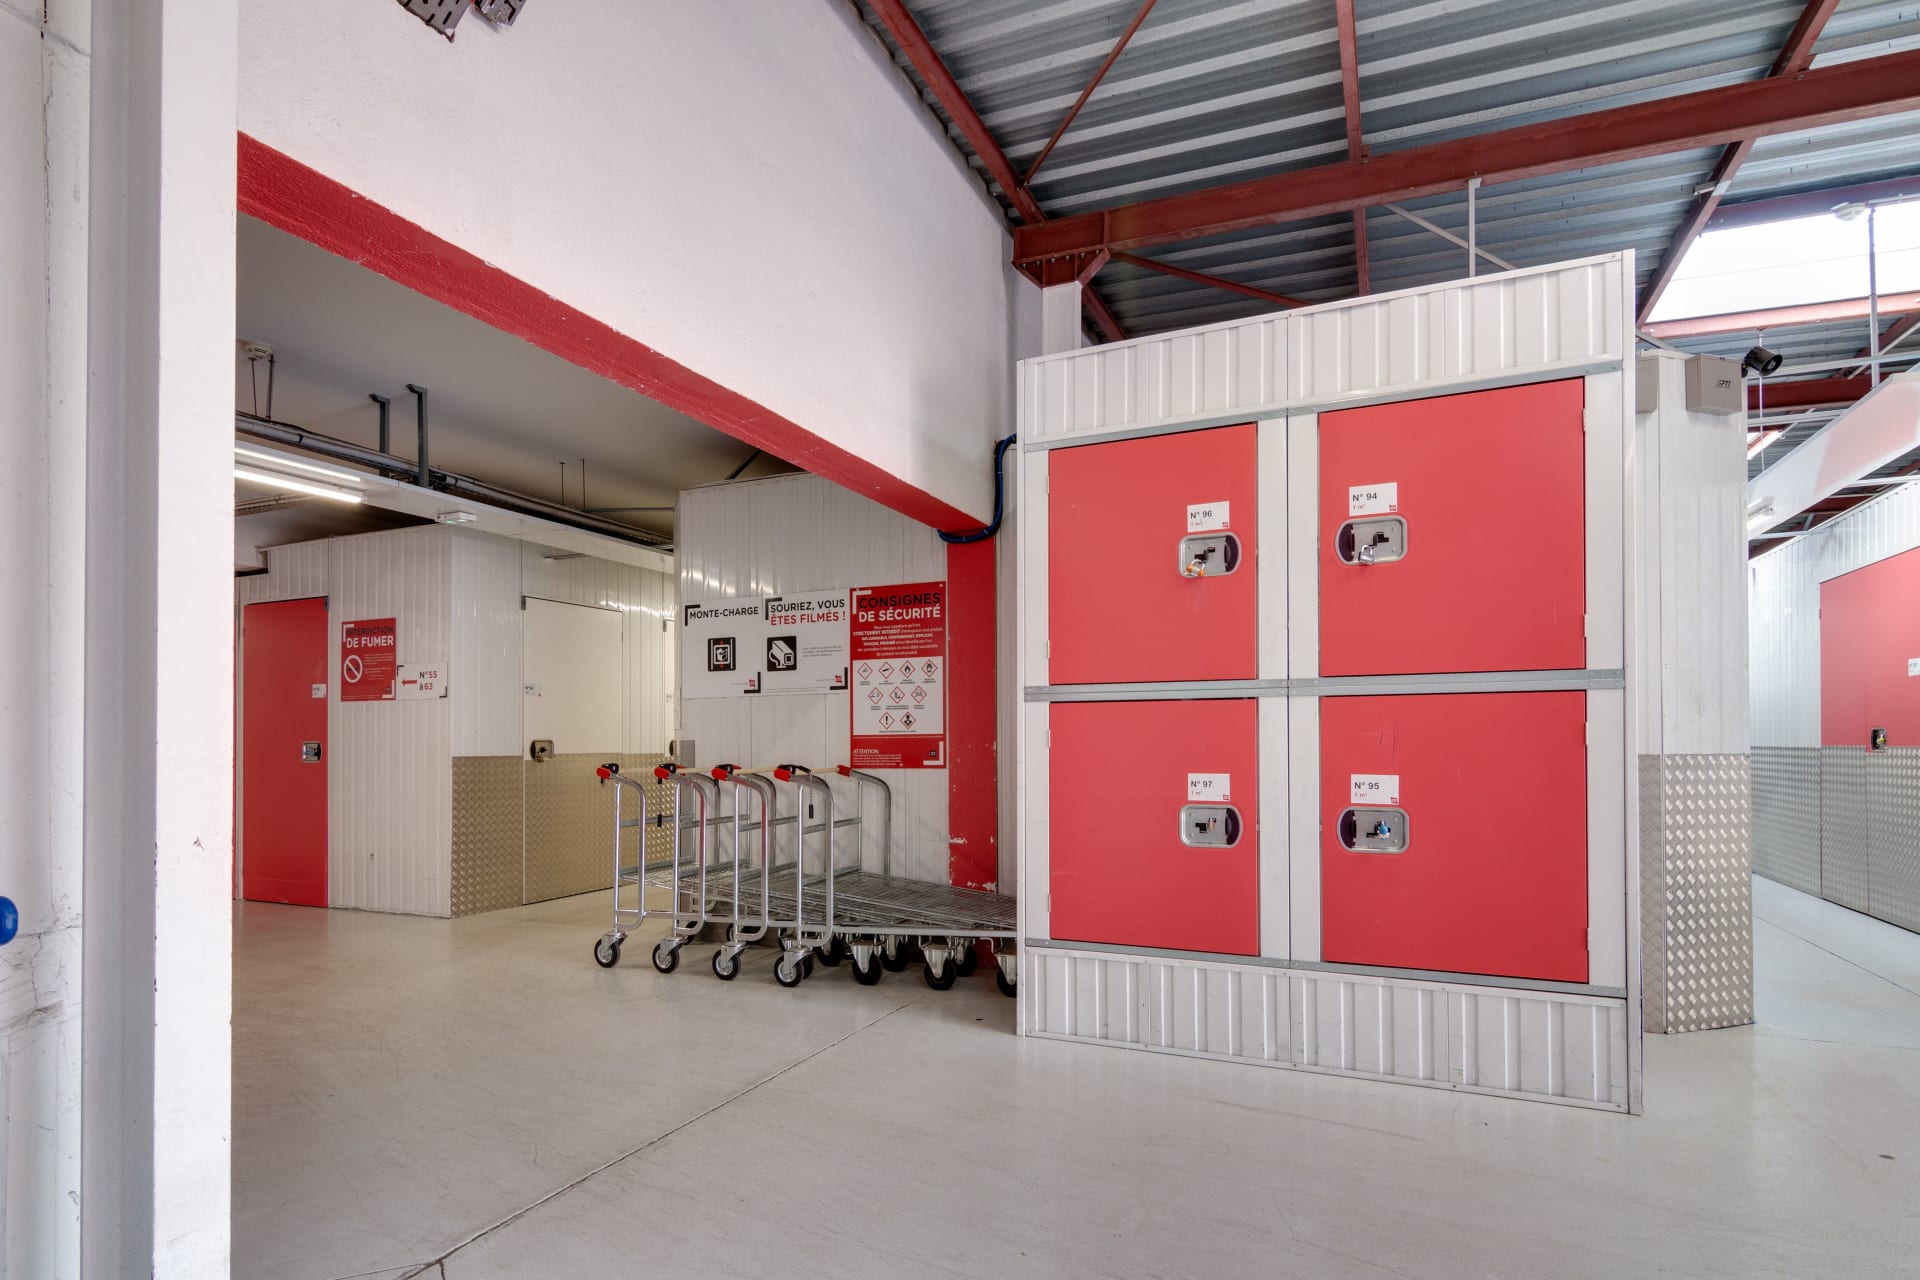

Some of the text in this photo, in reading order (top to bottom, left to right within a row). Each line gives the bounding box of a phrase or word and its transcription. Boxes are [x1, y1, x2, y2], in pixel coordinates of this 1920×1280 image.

[1366, 492, 1377, 500] 94
[1202, 510, 1213, 518] 96
[770, 599, 845, 613] SOURIEZ, VOUS
[858, 592, 941, 609] CONSIGNES
[689, 606, 759, 620] MONTE-CHARGE
[770, 613, 797, 626] ÊTES
[800, 611, 839, 624] FILMÉS
[858, 603, 941, 623] DE SÉCURITÉ
[346, 626, 393, 636] INTERDICTION
[346, 635, 394, 649] DE FUMER
[1202, 780, 1213, 788] 97
[1368, 782, 1380, 790] 95
